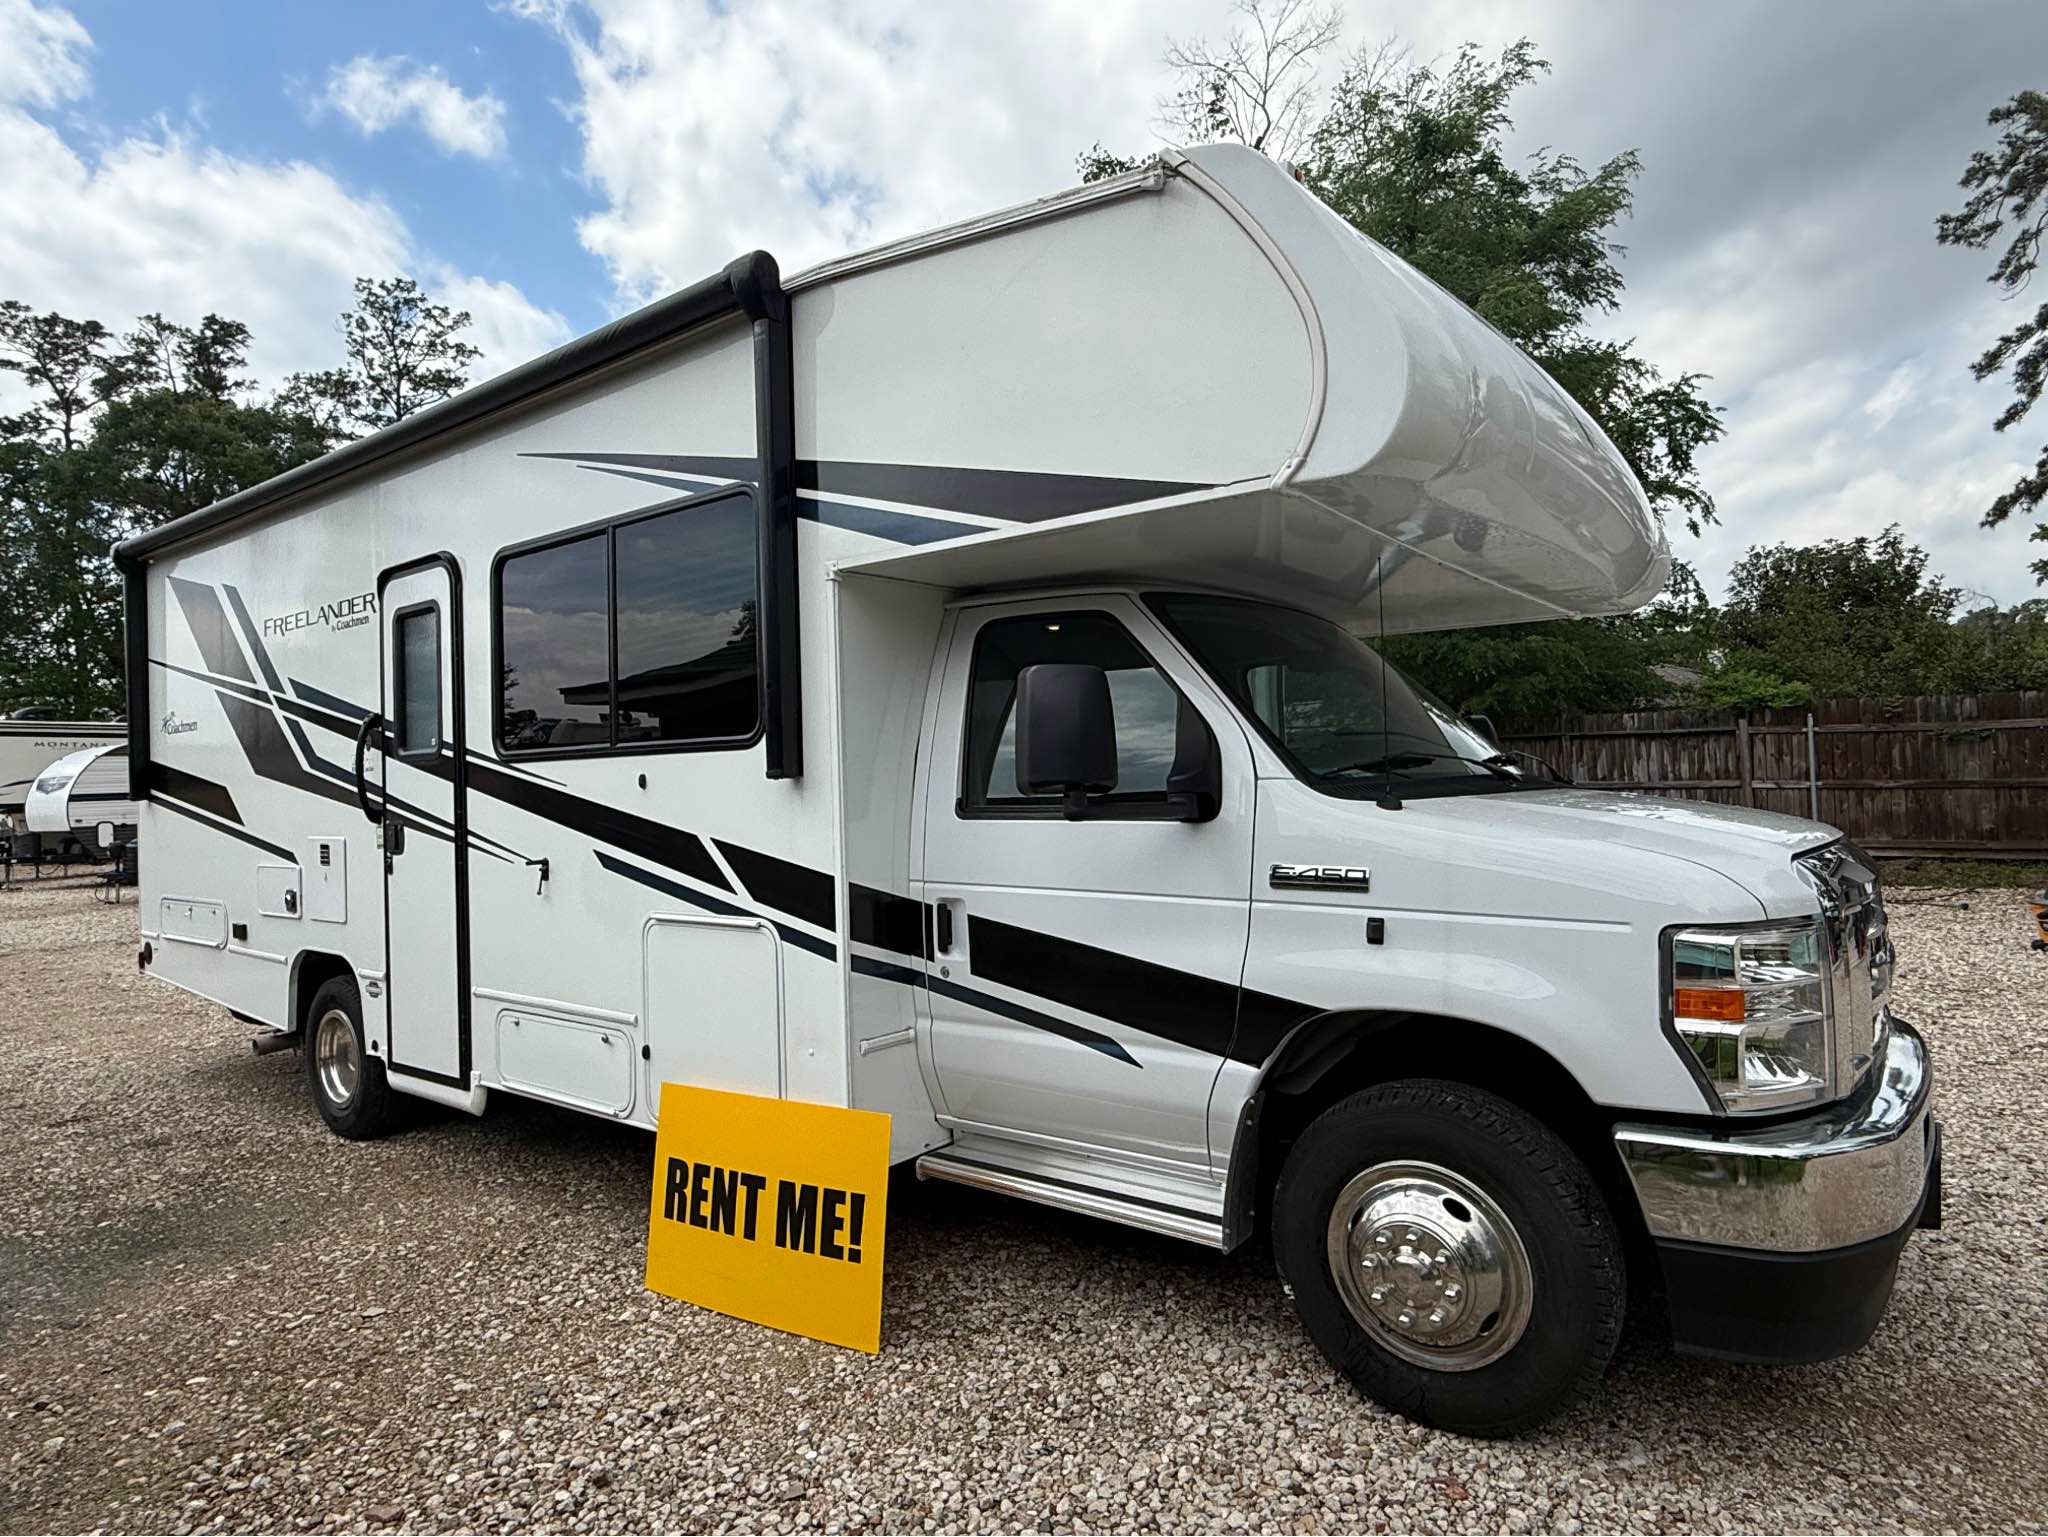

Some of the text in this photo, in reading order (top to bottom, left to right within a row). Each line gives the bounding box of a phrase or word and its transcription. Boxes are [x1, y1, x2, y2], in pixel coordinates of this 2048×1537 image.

[264, 592, 377, 637] FREELANDER
[337, 615, 370, 631] Coachmen
[33, 741, 109, 749] MONTANA
[1269, 864, 1369, 882] E-450
[663, 1156, 867, 1265] RENT ME!
